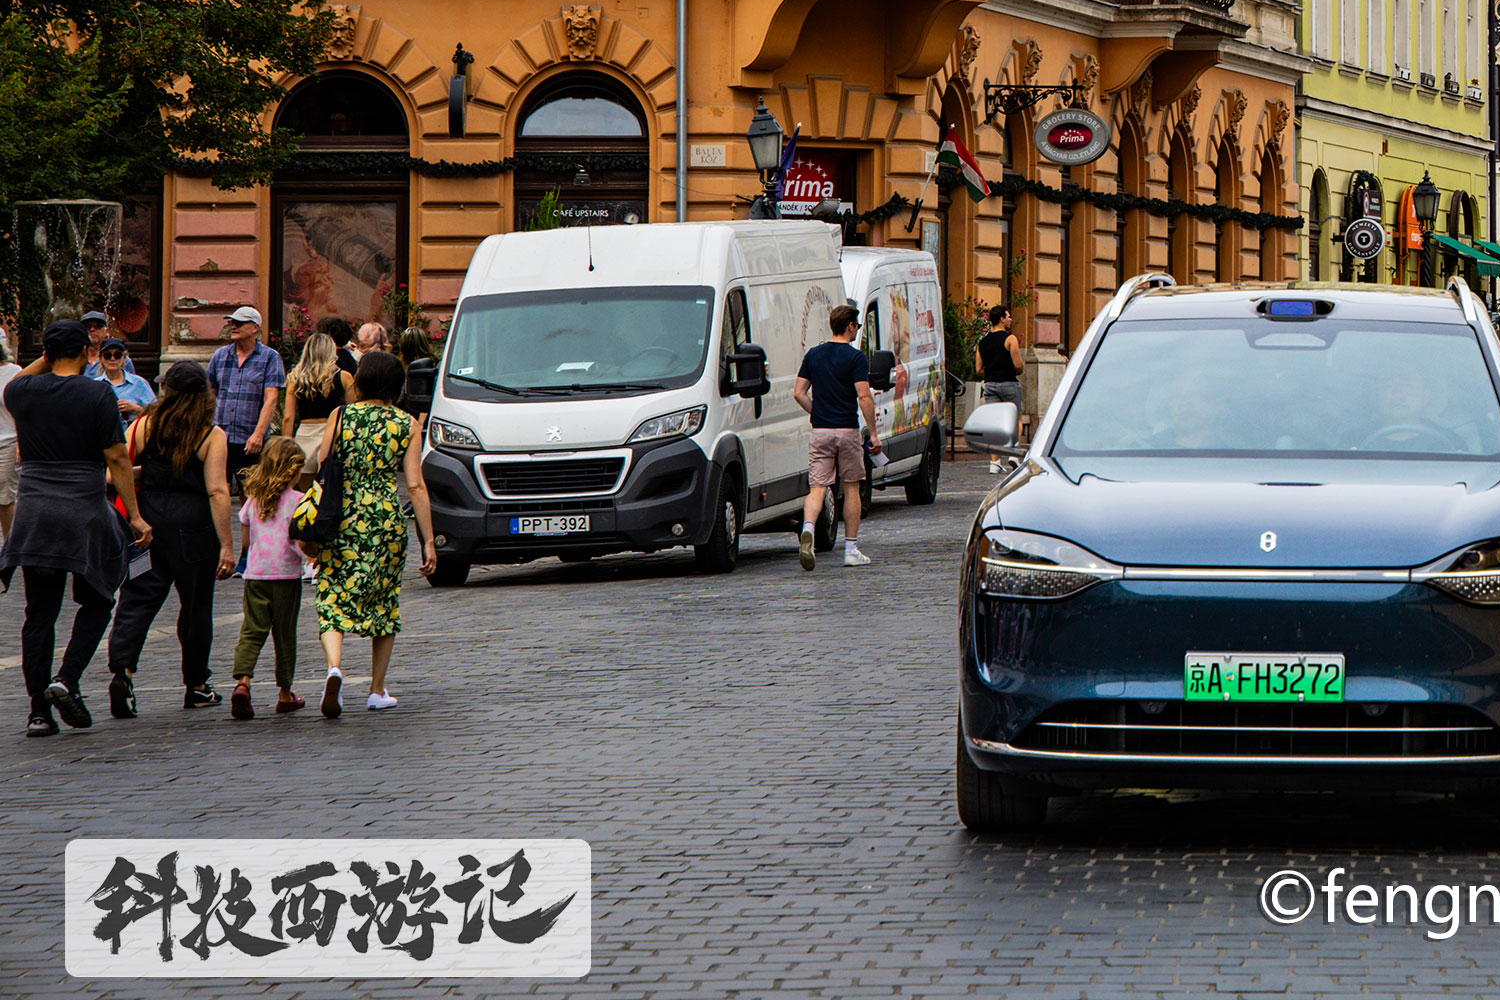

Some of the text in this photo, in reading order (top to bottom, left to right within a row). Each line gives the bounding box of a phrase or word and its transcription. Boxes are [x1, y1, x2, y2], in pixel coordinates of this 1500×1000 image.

[1042, 113, 1101, 131] GROCERY STORE
[695, 148, 722, 156] BALTA
[701, 153, 718, 164] KÖZ
[783, 174, 834, 198] ríma
[574, 209, 609, 217] UPSTAIRS
[1360, 235, 1368, 243] T
[521, 517, 586, 532] PPT-392
